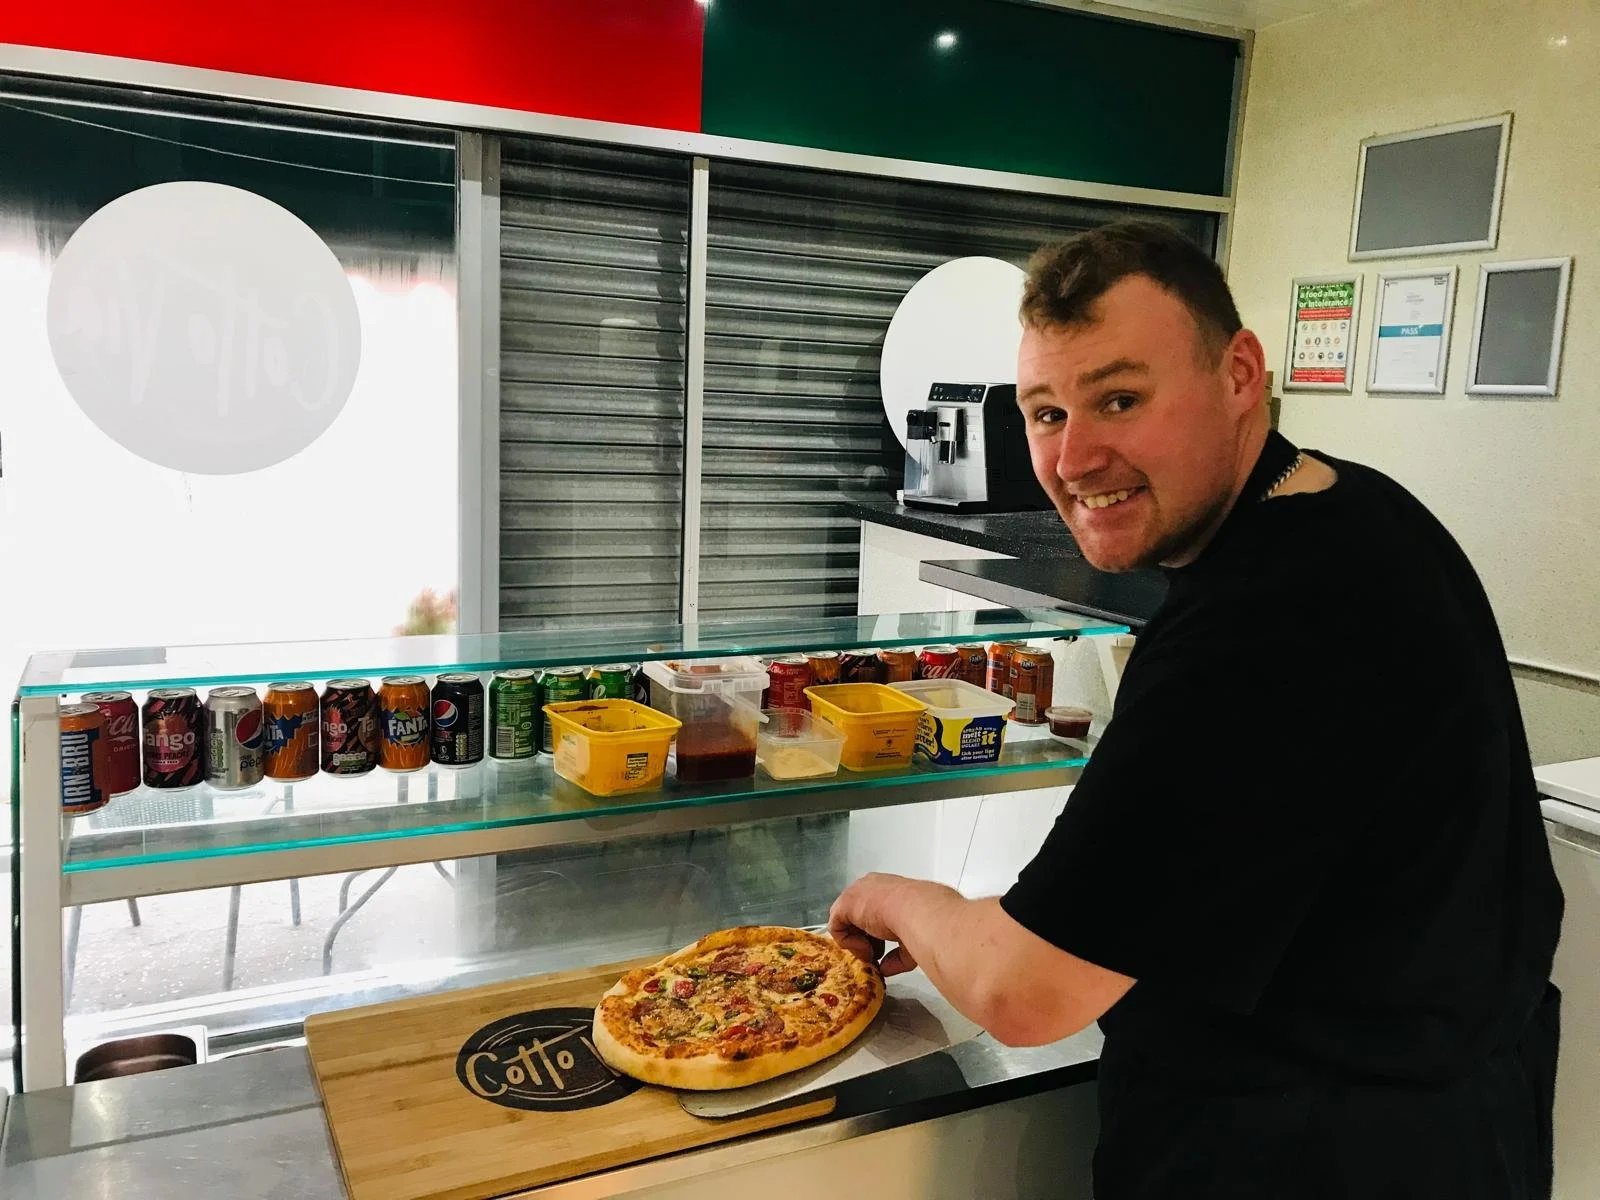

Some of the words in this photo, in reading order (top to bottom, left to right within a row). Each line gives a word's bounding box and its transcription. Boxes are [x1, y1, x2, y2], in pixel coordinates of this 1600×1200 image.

[1306, 290, 1323, 298] food
[1323, 289, 1348, 298] allergy
[1308, 299, 1348, 308] intolerance
[1401, 327, 1419, 335] PASS
[388, 716, 428, 737] FANTA
[962, 731, 981, 739] melt
[981, 731, 997, 745] it
[465, 1025, 588, 1097] Cotto
